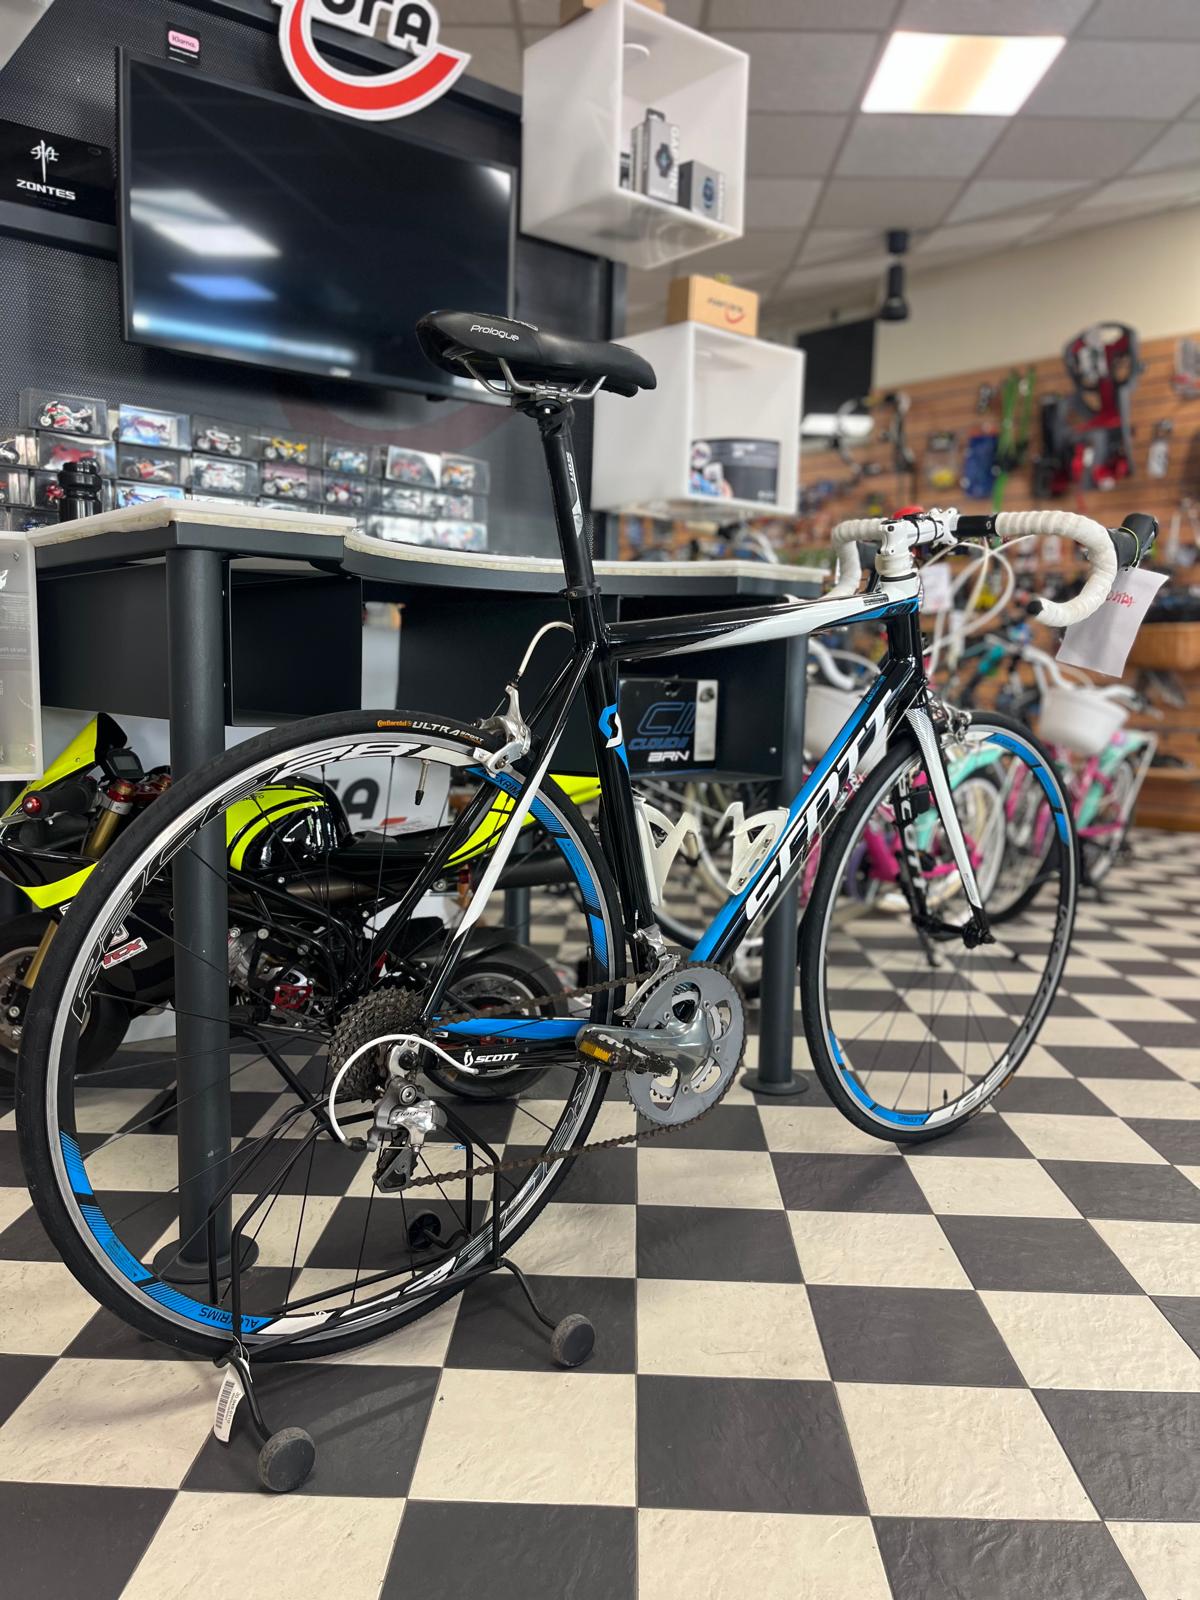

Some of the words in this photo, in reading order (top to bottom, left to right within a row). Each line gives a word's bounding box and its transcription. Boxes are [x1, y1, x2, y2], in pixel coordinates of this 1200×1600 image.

[16, 179, 76, 200] ZONTES
[470, 324, 520, 342] Prologue
[412, 721, 461, 736] ULTRA
[648, 750, 690, 762] BRN
[104, 941, 142, 966] TCX
[474, 1053, 519, 1063] SCOTT
